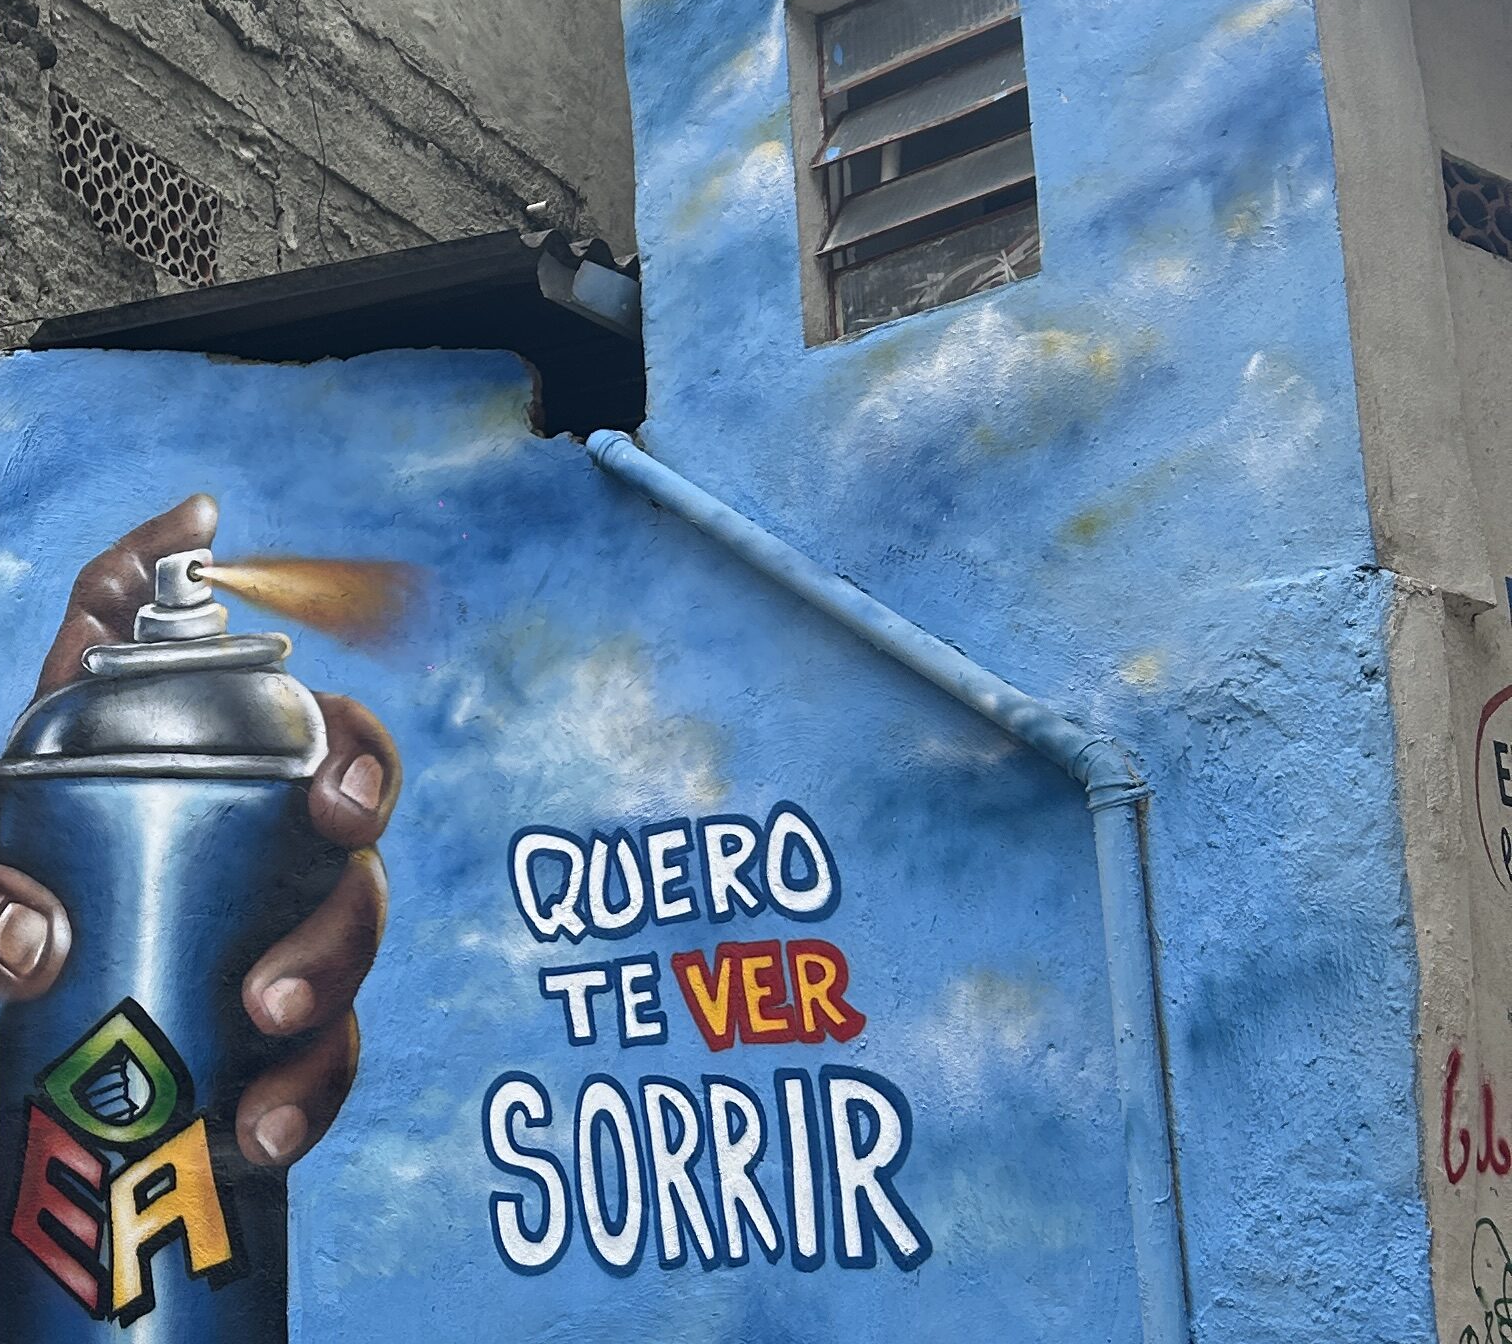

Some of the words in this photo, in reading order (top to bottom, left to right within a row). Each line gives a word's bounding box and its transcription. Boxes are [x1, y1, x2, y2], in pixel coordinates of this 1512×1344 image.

[509, 802, 840, 942] QUERO
[540, 953, 666, 1046] TE
[673, 941, 866, 1051] VER
[484, 1066, 932, 1275] SORRIR
